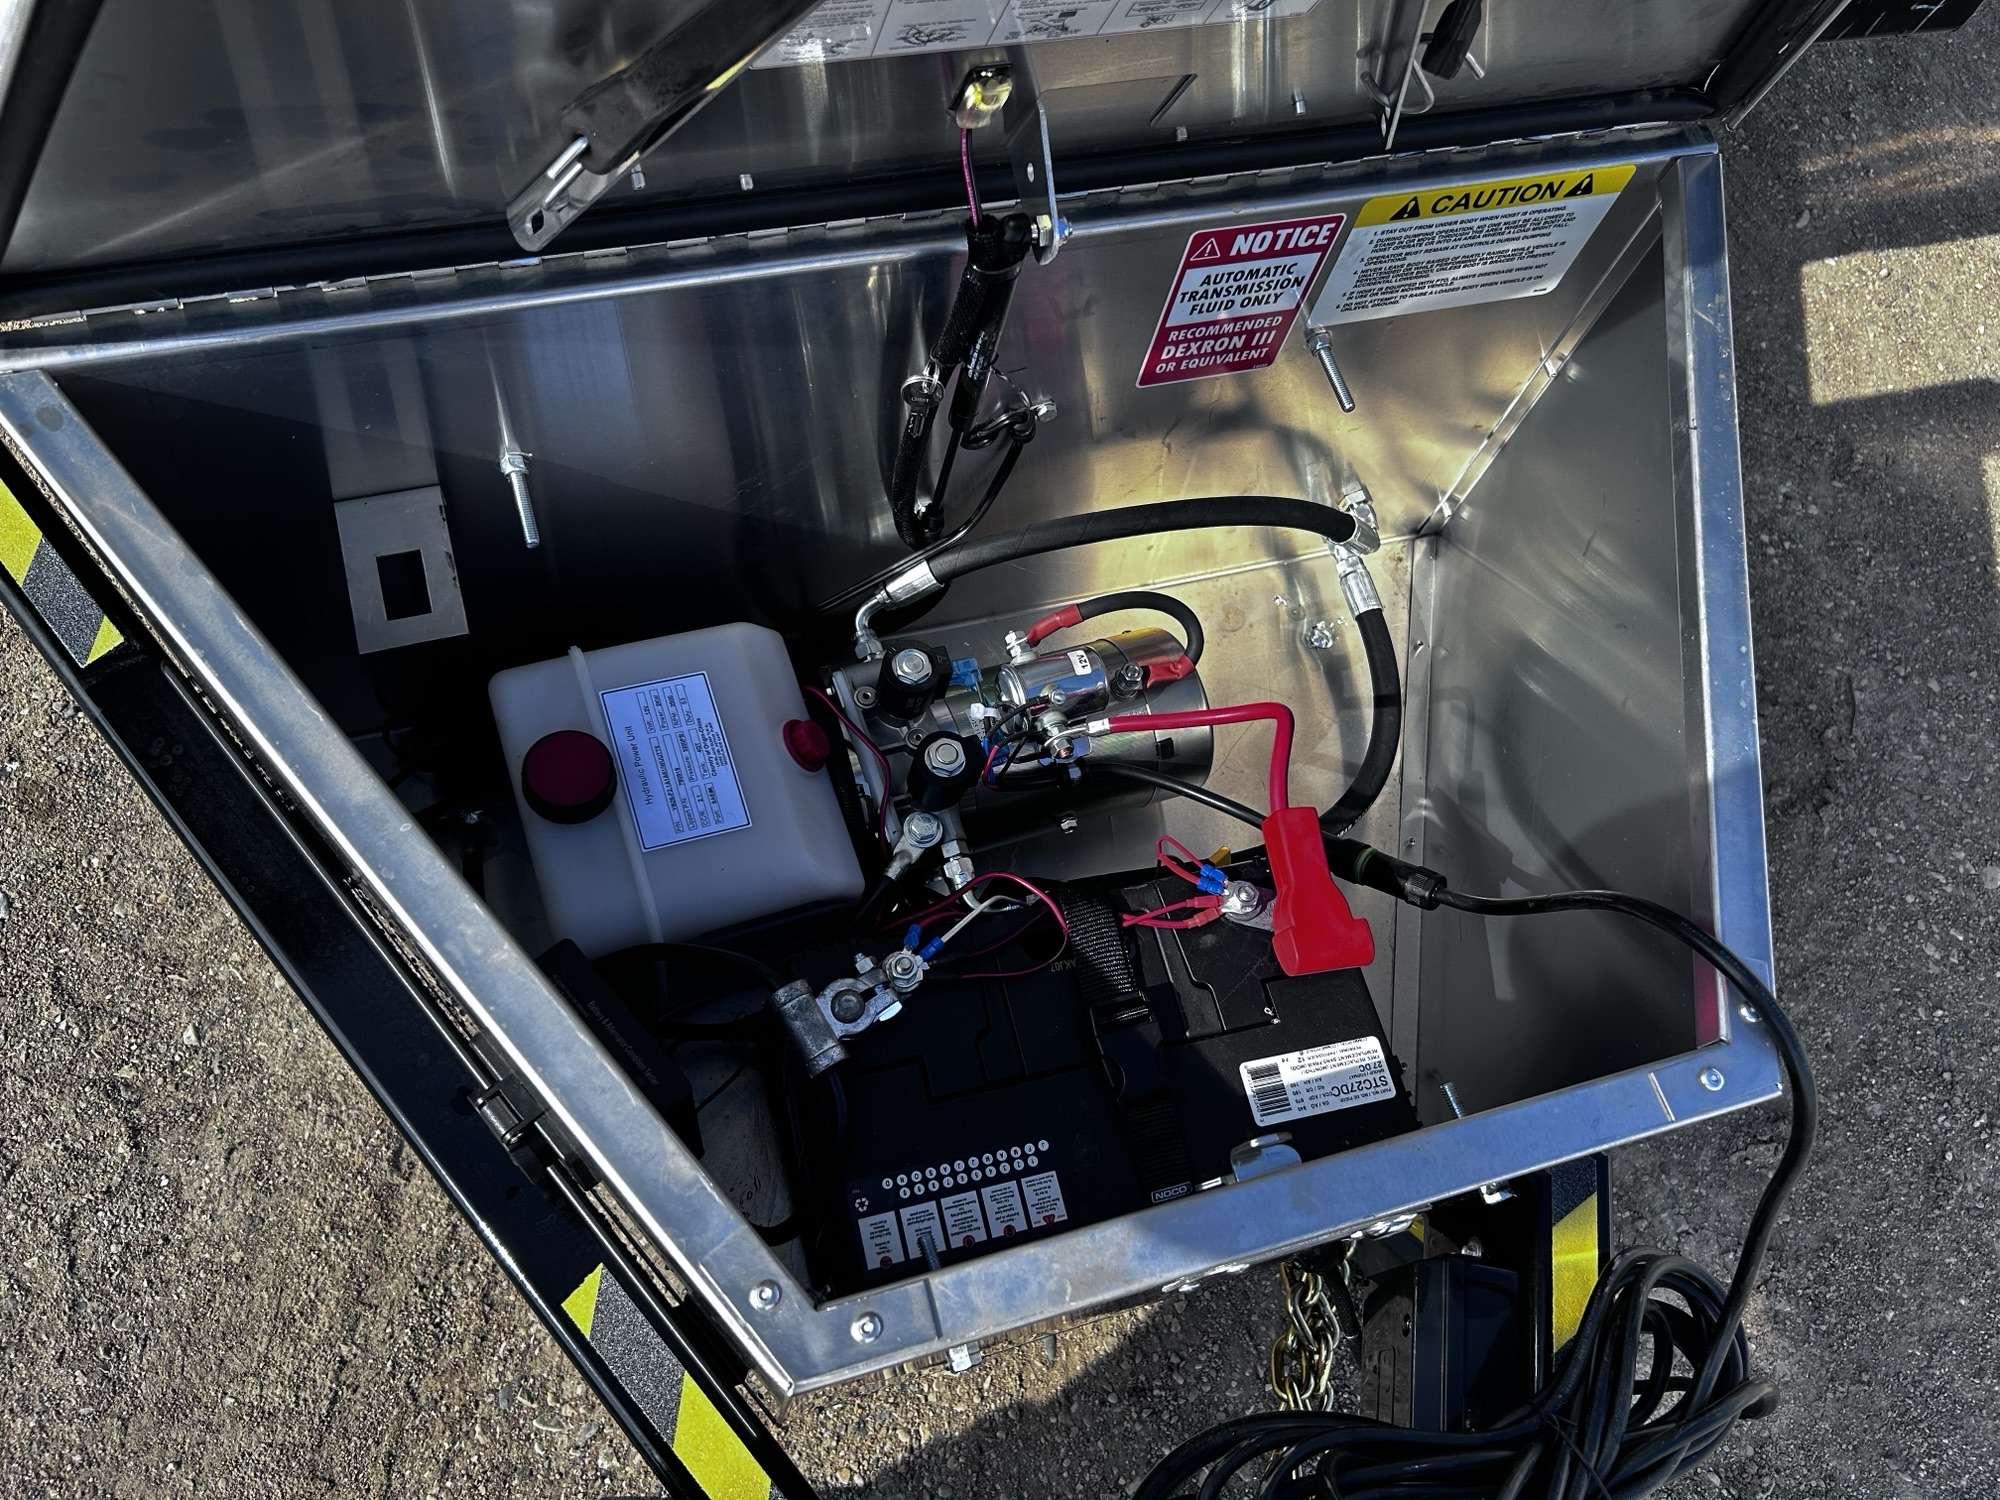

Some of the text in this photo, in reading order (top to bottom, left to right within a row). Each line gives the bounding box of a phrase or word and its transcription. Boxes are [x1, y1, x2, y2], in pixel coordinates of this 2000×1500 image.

[1431, 180, 1565, 214] CAUTION
[1404, 231, 1434, 240] DUMPING
[1532, 213, 1564, 222] ALLOWED
[1435, 220, 1458, 228] UNDER
[1438, 231, 1470, 239] THROUGH
[1230, 223, 1336, 256] NOTICE
[1367, 252, 1403, 262] OPERATOR
[1459, 240, 1495, 249] CONTROLS
[1496, 236, 1521, 244] DURING
[1522, 232, 1551, 240] DUMPING
[1392, 242, 1424, 250] OPERATE
[1200, 262, 1298, 287] AUTOMATIC
[1355, 275, 1390, 284] SERVICING
[1489, 257, 1516, 265] BRACED
[1526, 251, 1555, 259] PREVENT
[1358, 269, 1402, 279] UNATTENDED
[1435, 258, 1477, 268] PERFORMING
[1478, 252, 1523, 261] MAINTENANCE
[1180, 275, 1305, 303] TRANSMISSION
[1353, 279, 1392, 288] ACCIDENTAL
[1368, 296, 1398, 304] ATTEMPT
[1500, 277, 1525, 285] VEHICLE
[1385, 282, 1417, 291] EQUIPPED
[1189, 292, 1284, 316] FLUID ONLY
[1168, 316, 1283, 342] RECOMMENDED
[1161, 330, 1276, 360] DEXRON III
[1156, 362, 1176, 373] OR
[1180, 348, 1269, 370] EQUIVALENT
[1077, 655, 1088, 669] 12V
[625, 726, 654, 805] Hydraulic Power Unit
[1359, 1061, 1382, 1072] 27 DC
[1331, 1075, 1388, 1097] STC27DC
[1155, 1186, 1187, 1200] NOCO
